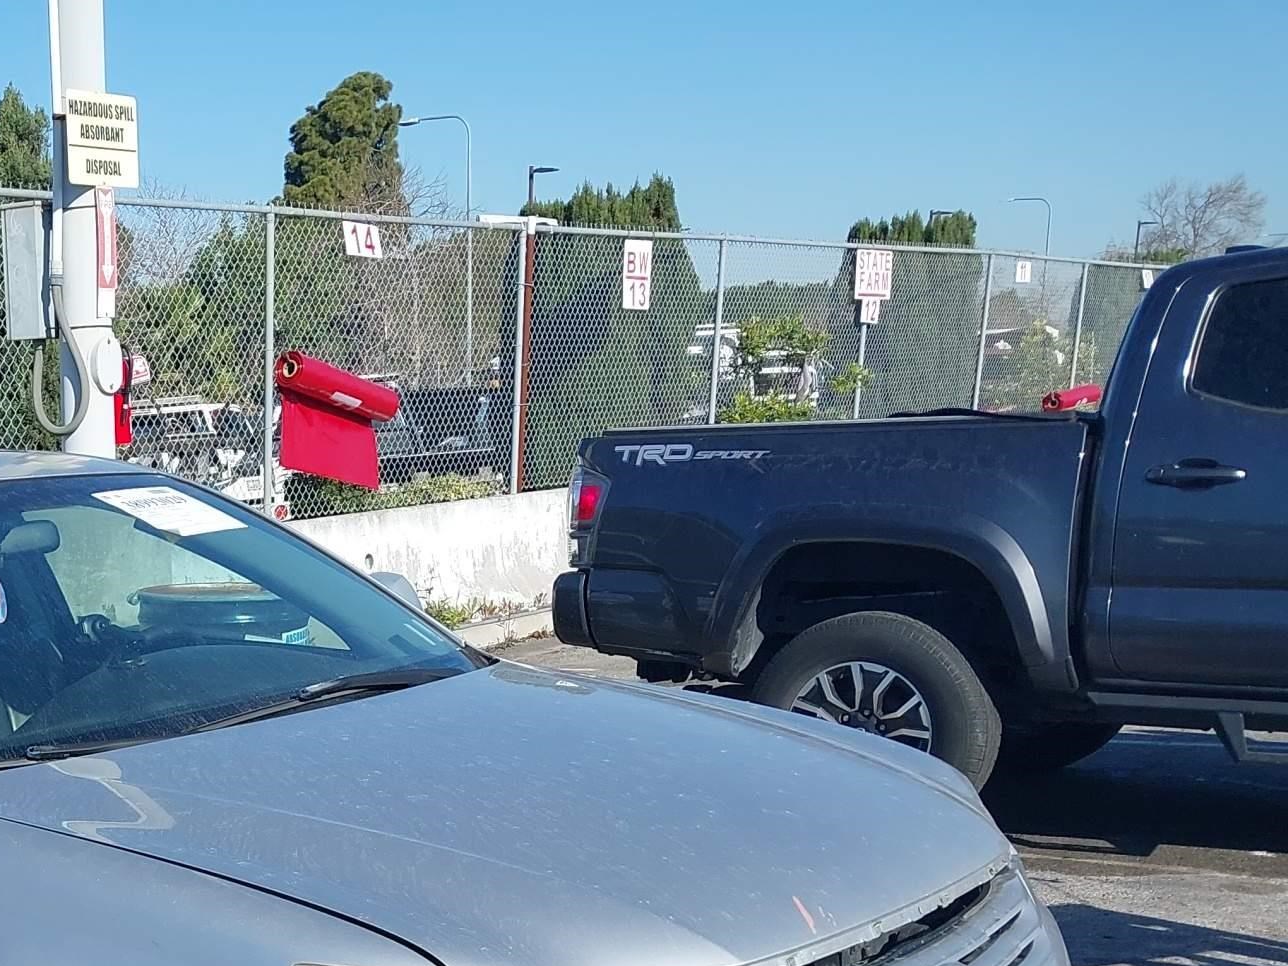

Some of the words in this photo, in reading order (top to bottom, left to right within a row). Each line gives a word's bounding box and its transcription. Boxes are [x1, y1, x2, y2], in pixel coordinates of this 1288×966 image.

[68, 98, 113, 120] HAZARDOUS
[114, 104, 134, 122] SPILL
[80, 123, 125, 143] ABSORBANT
[85, 158, 122, 177] DISPOSAL
[351, 224, 376, 256] 14
[627, 251, 649, 274] BW
[859, 251, 891, 272] STATE
[859, 271, 889, 292] FARM
[629, 282, 646, 307] 13
[864, 300, 877, 322] 12
[614, 444, 693, 466] TRD
[692, 450, 771, 460] SPORT
